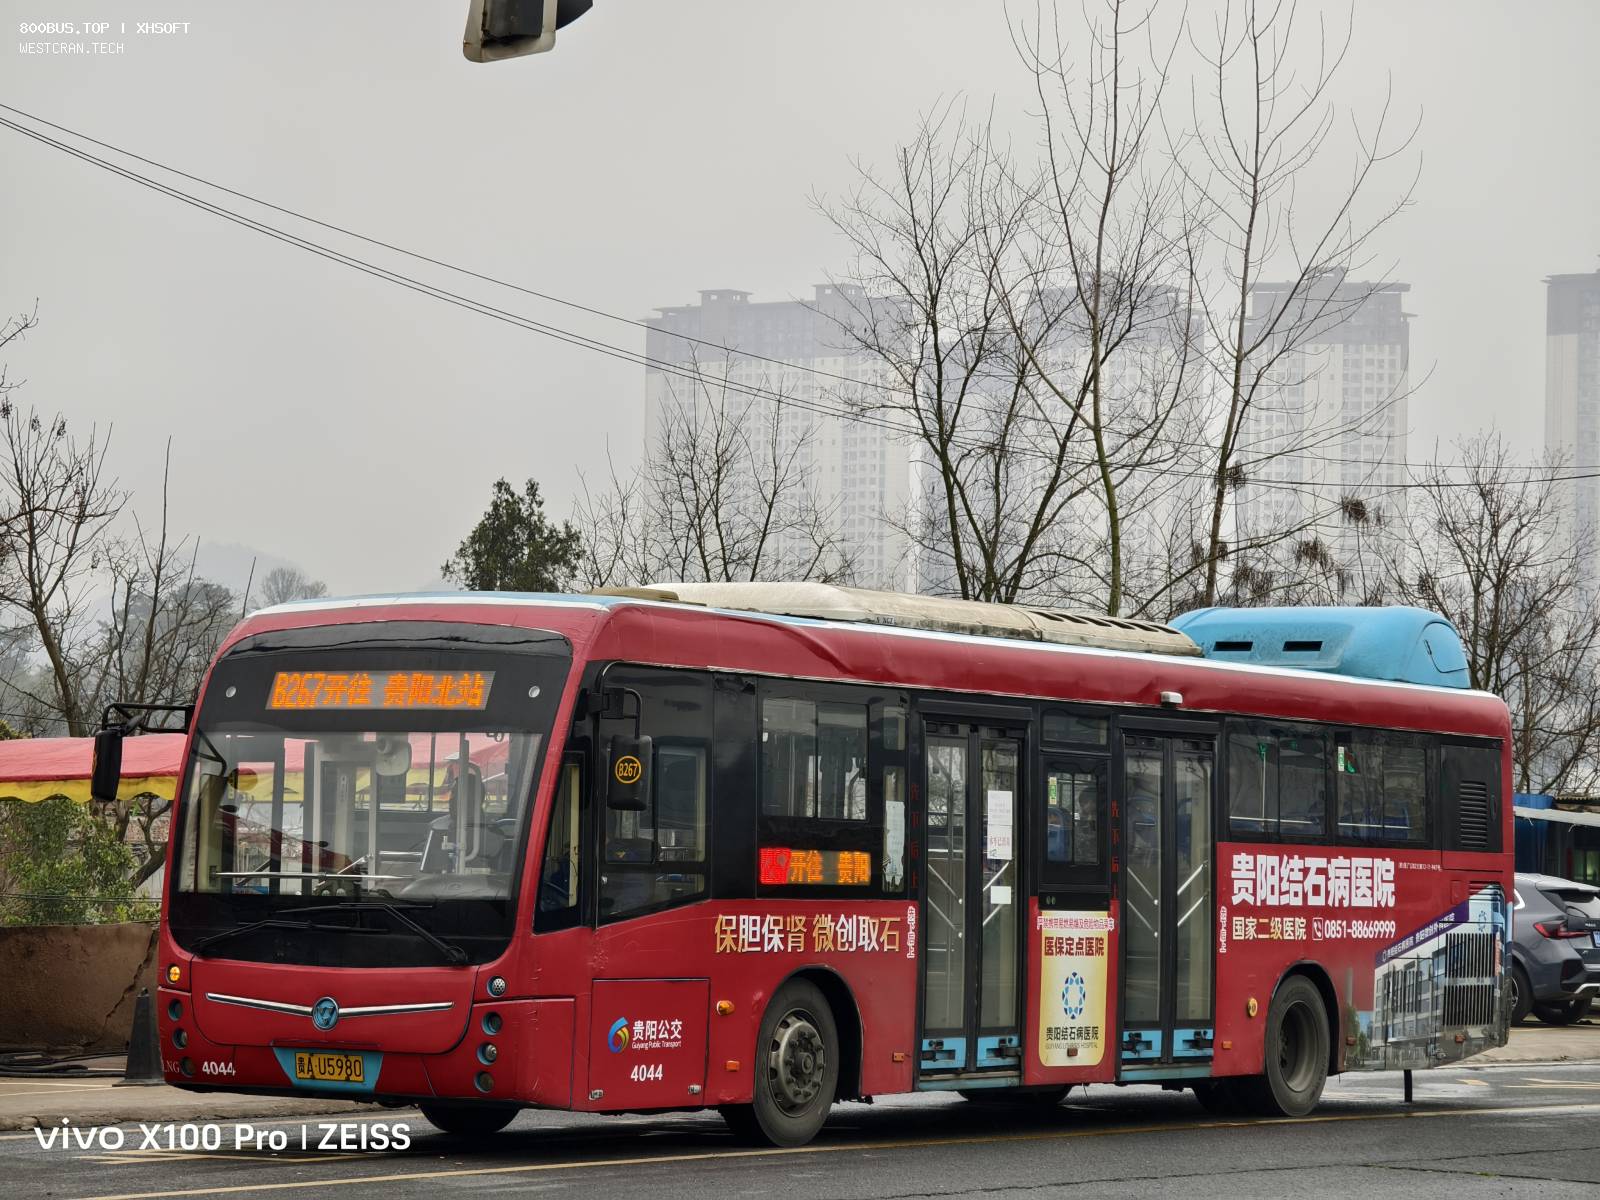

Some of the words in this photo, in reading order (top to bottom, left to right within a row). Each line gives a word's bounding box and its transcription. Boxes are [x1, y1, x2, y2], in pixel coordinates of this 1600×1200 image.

[383, 672, 485, 707] 贵阳北站
[618, 762, 638, 777] B267
[838, 851, 869, 883] 贵阳
[1231, 853, 1396, 908] 贵阳结石病医院
[714, 914, 808, 953] 保胆保肾
[812, 914, 901, 952] 微创取石
[1232, 916, 1307, 940] 国家二级医院
[1324, 920, 1396, 939] 0851-88669999
[1044, 936, 1105, 957] 医保定点医院
[632, 1019, 683, 1041] 贵阳公交
[1046, 1026, 1099, 1041] 贵阳结石病医院
[631, 1041, 648, 1050] Guiyang
[662, 1040, 682, 1049] Transport
[202, 1061, 236, 1076] 4044
[630, 1063, 663, 1081] 4044
